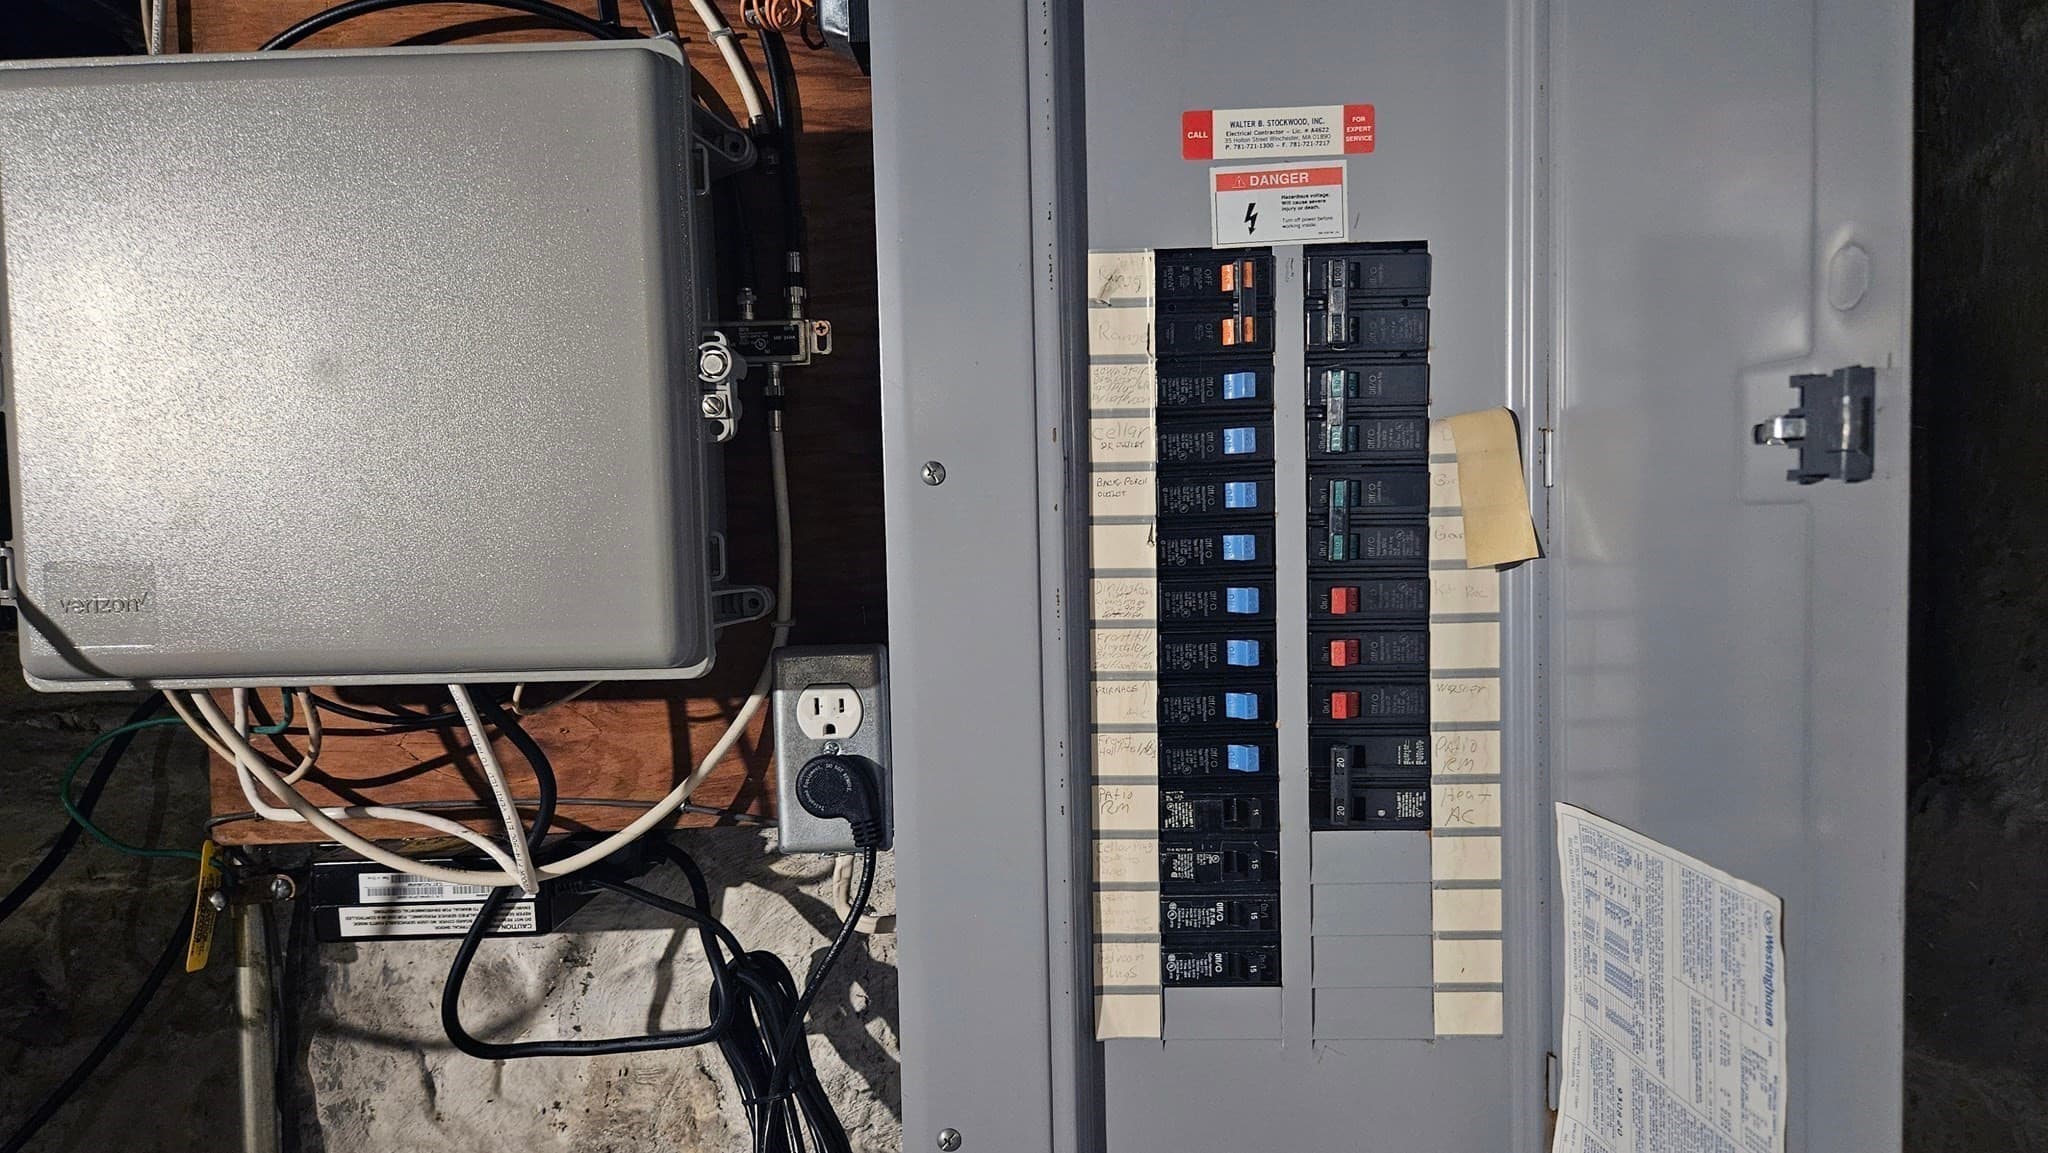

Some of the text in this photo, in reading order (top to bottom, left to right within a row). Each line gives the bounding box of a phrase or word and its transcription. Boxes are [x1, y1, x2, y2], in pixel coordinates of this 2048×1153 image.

[1230, 120, 1256, 128] WALTER
[1266, 118, 1310, 127] STOCKWOOD,
[1187, 131, 1208, 140] CALL
[1250, 172, 1310, 186] DANGER
[60, 594, 140, 614] verizon
[1336, 757, 1344, 768] 20
[1336, 805, 1344, 816] 20
[1444, 806, 1474, 826] AC
[1251, 859, 1258, 869] 15
[1216, 902, 1224, 921] Off/O
[1214, 953, 1223, 972] Off/O
[1250, 965, 1257, 973] 15
[1763, 934, 1775, 1028] Westinghouse
